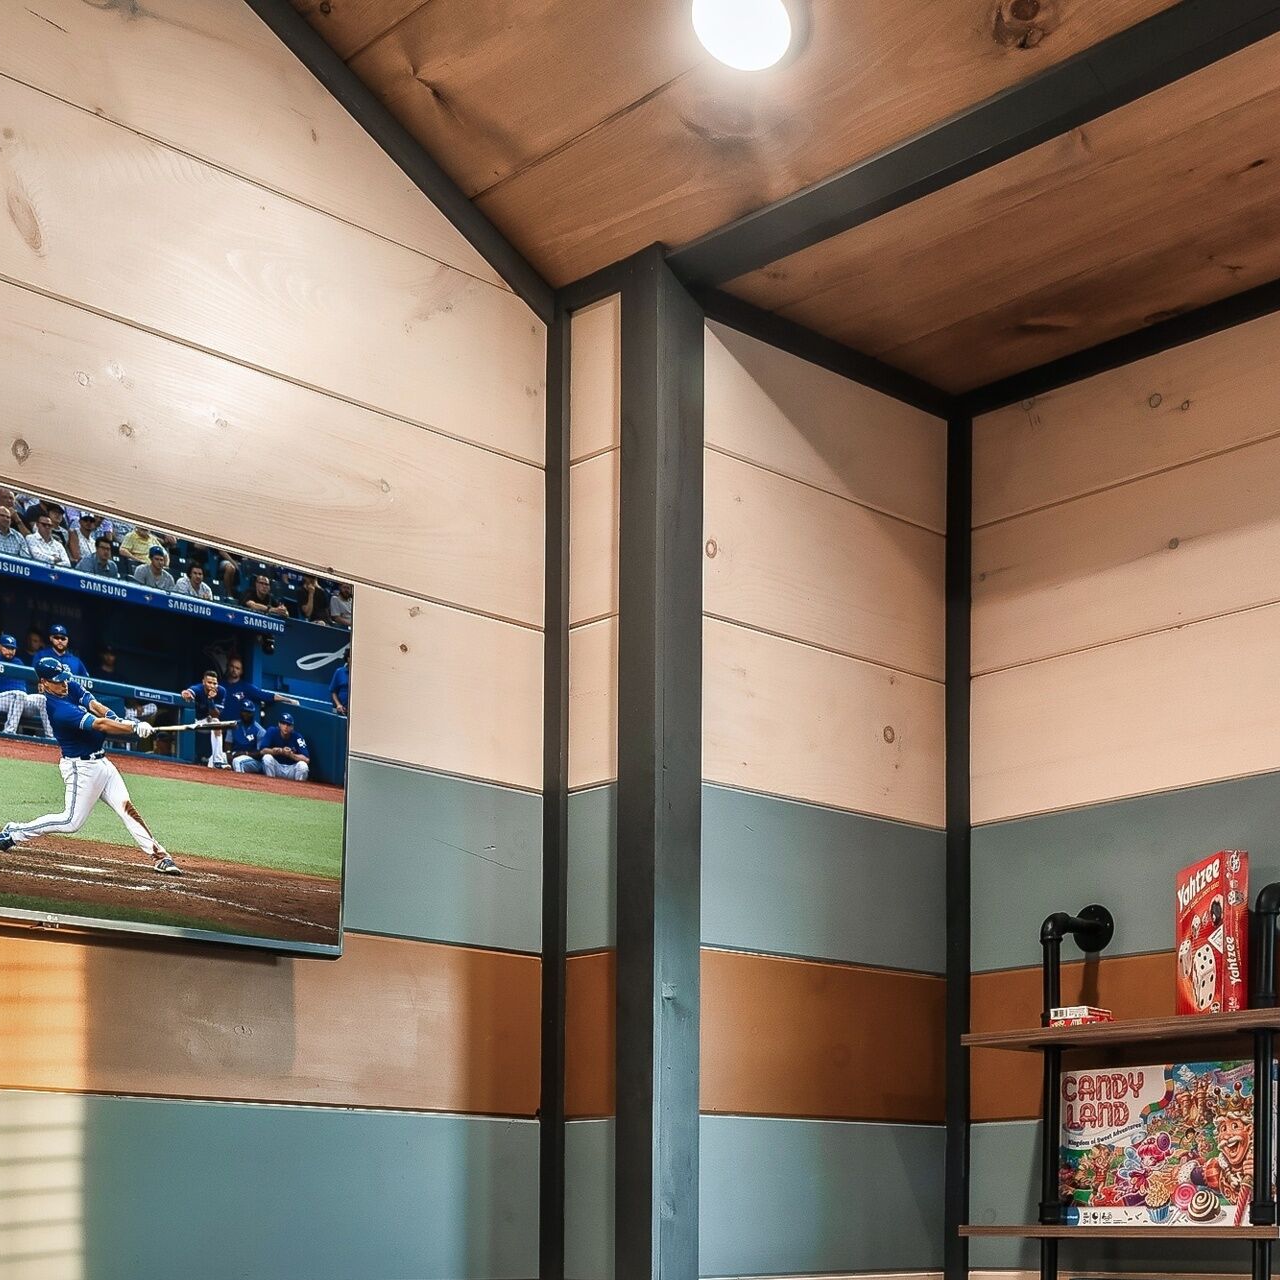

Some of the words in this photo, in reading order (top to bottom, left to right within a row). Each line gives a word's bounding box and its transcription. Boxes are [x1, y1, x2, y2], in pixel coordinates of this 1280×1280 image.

[79, 579, 127, 598] SAMSUNG
[168, 599, 212, 616] SAMSUNG
[243, 615, 285, 633] SAMSUNG
[1177, 858, 1220, 914] Yahtzee
[1226, 936, 1242, 985] Yahtzee
[1061, 1071, 1144, 1102] CANDY
[1066, 1101, 1129, 1131] LAND
[1097, 1133, 1113, 1143] Sweet
[1113, 1122, 1142, 1138] Adventures
